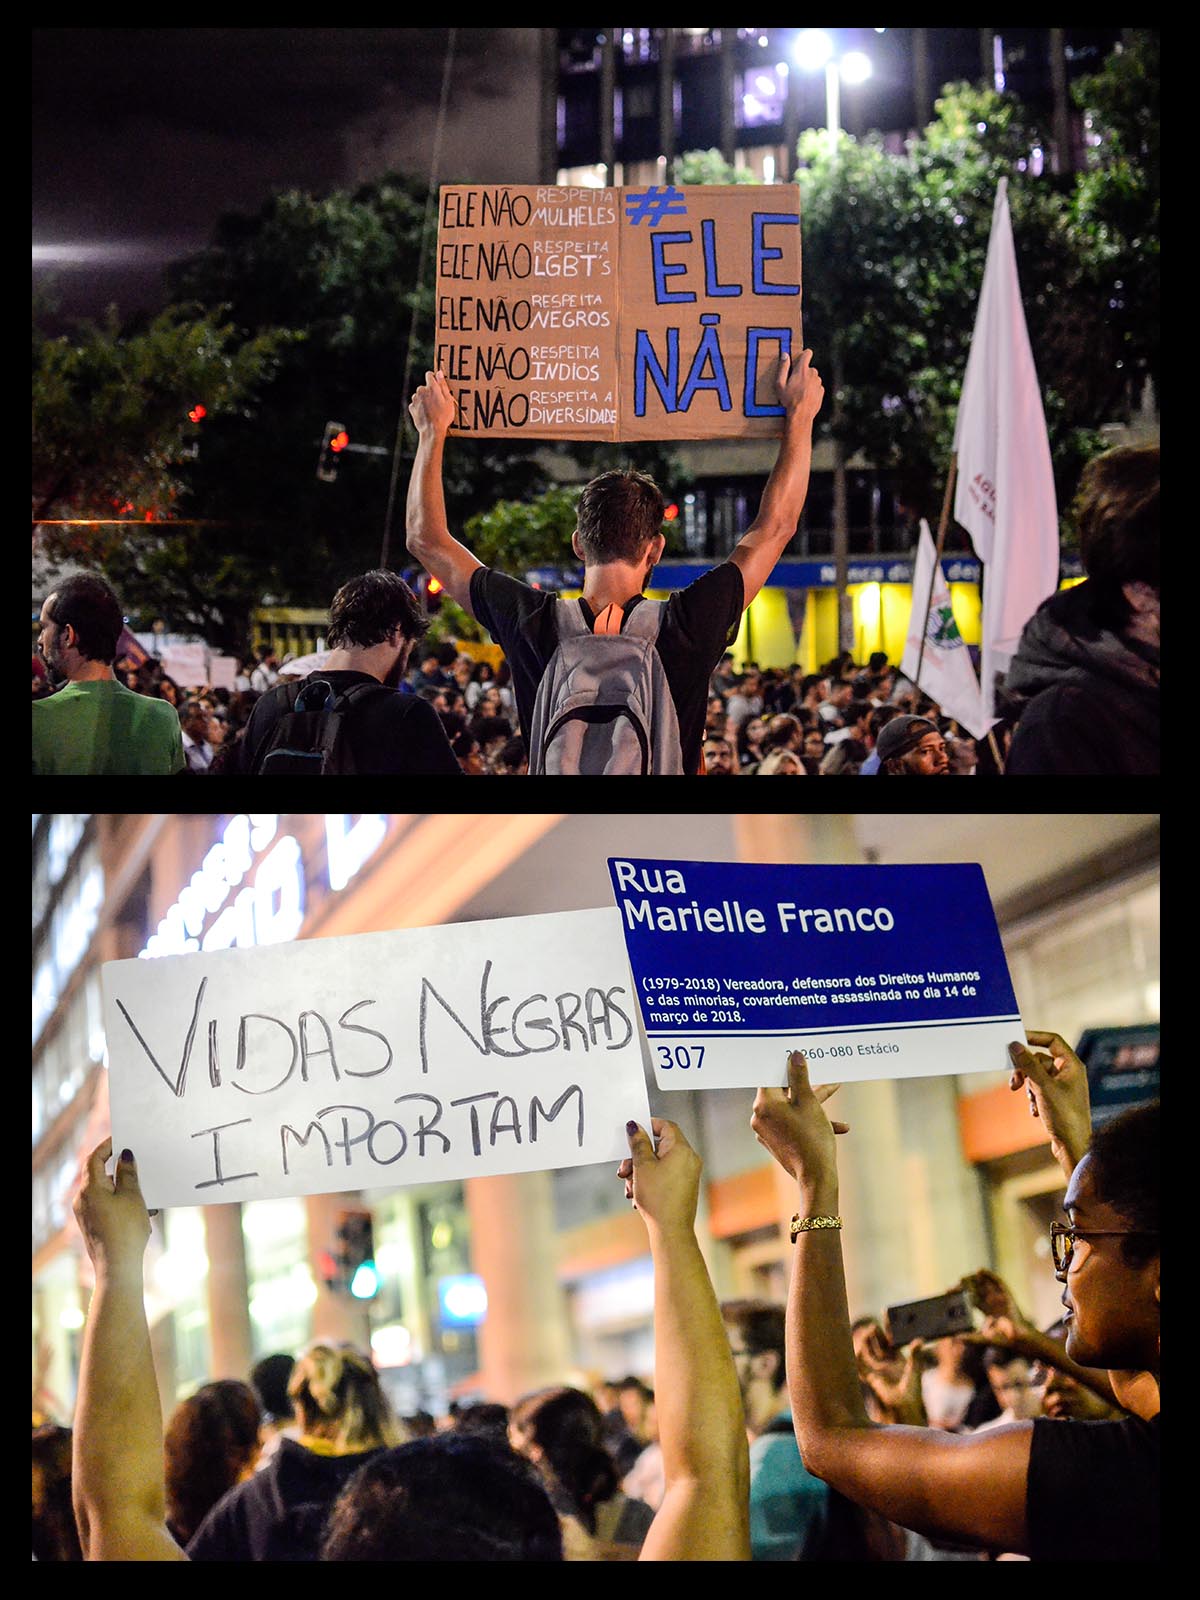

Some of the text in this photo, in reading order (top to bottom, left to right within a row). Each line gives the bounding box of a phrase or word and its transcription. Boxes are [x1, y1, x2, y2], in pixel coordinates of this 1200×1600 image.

[443, 187, 532, 228] ELE NÃO
[536, 188, 613, 203] RESPEITA
[534, 241, 608, 253] RESPEITA
[650, 212, 801, 305] ELE
[440, 240, 532, 281] ELE NÃO
[531, 295, 602, 308] RESPEITA
[439, 296, 531, 332] ELE NÃO
[530, 311, 610, 329] NEGROS
[476, 343, 530, 381] NÃO
[531, 346, 599, 360] RESPEITA
[634, 313, 792, 418] NÃO
[474, 386, 529, 430] NÃO
[530, 390, 613, 404] RESPEITA A
[530, 406, 617, 424] DIVERSIDADE
[614, 861, 687, 894] Rua
[624, 899, 894, 933] Marielle Franco
[642, 970, 981, 992] (1979-2018) Vereadora, defensora dos Direitos Humanos
[646, 985, 977, 1008] e das minorias, covardemente assassinada no dia 14 de
[116, 960, 634, 1098] VIDAS NEGRAS
[650, 1010, 746, 1025] março de 2018.
[657, 1045, 705, 1070] 307
[857, 1042, 900, 1056] Estácio
